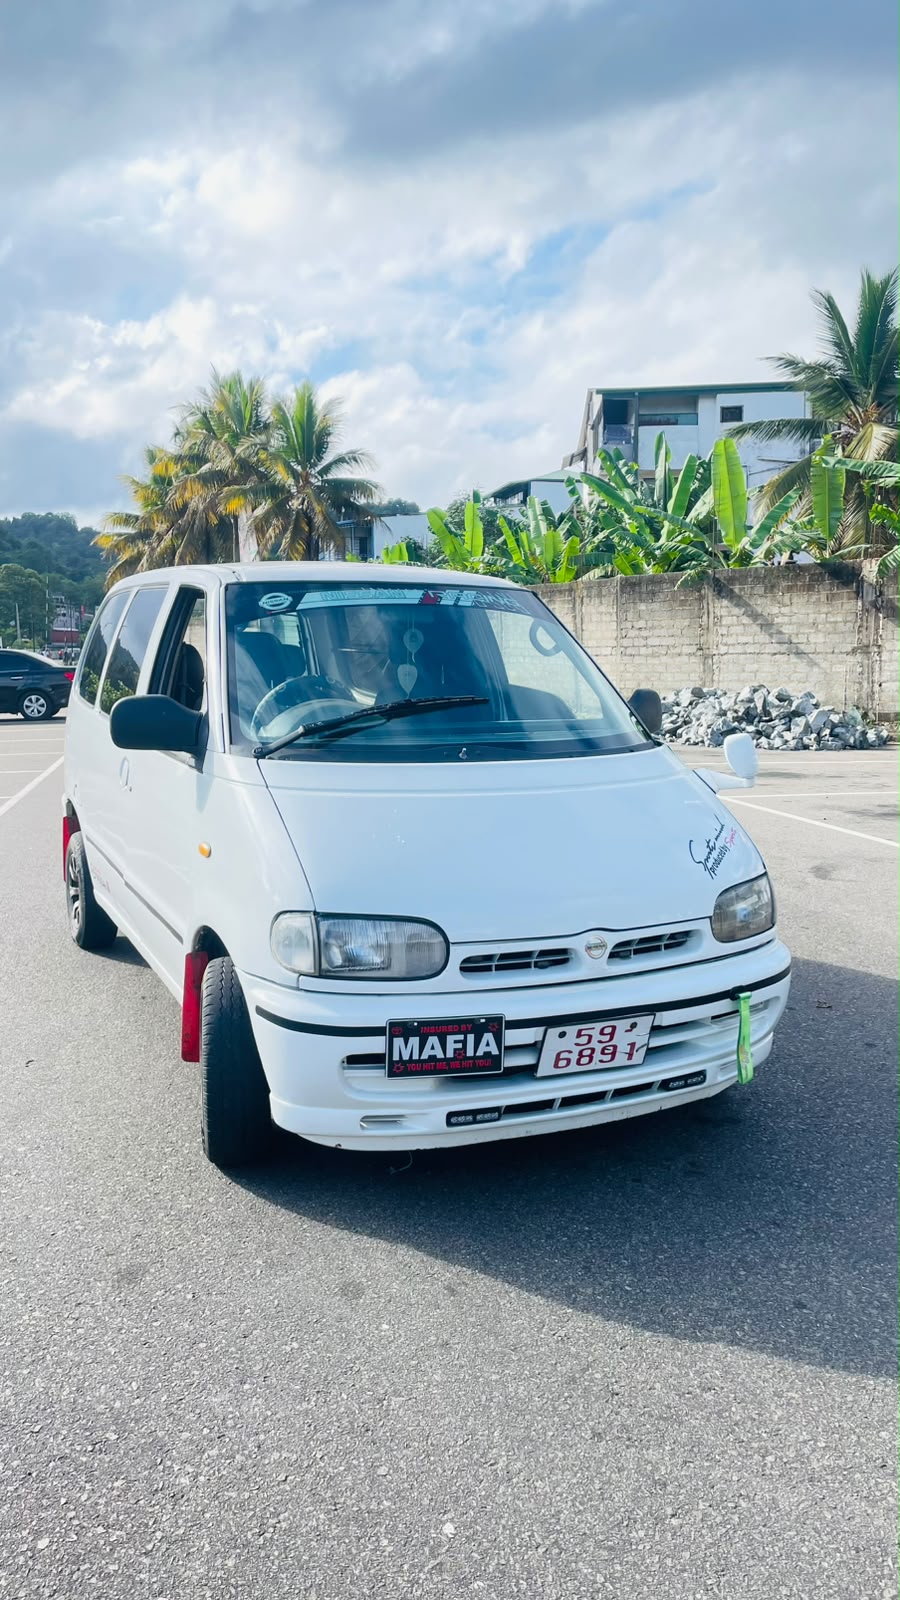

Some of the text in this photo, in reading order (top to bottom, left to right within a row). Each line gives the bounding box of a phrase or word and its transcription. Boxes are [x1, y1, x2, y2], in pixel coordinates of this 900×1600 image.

[262, 597, 289, 605] NISSAN
[421, 1023, 472, 1034] INSURED BY
[393, 1032, 499, 1061] MAFIA
[553, 1042, 637, 1069] 6891
[406, 1063, 422, 1071] YOU
[423, 1062, 436, 1071] HIT
[450, 1061, 461, 1069] WE
[462, 1060, 473, 1068] HIT
